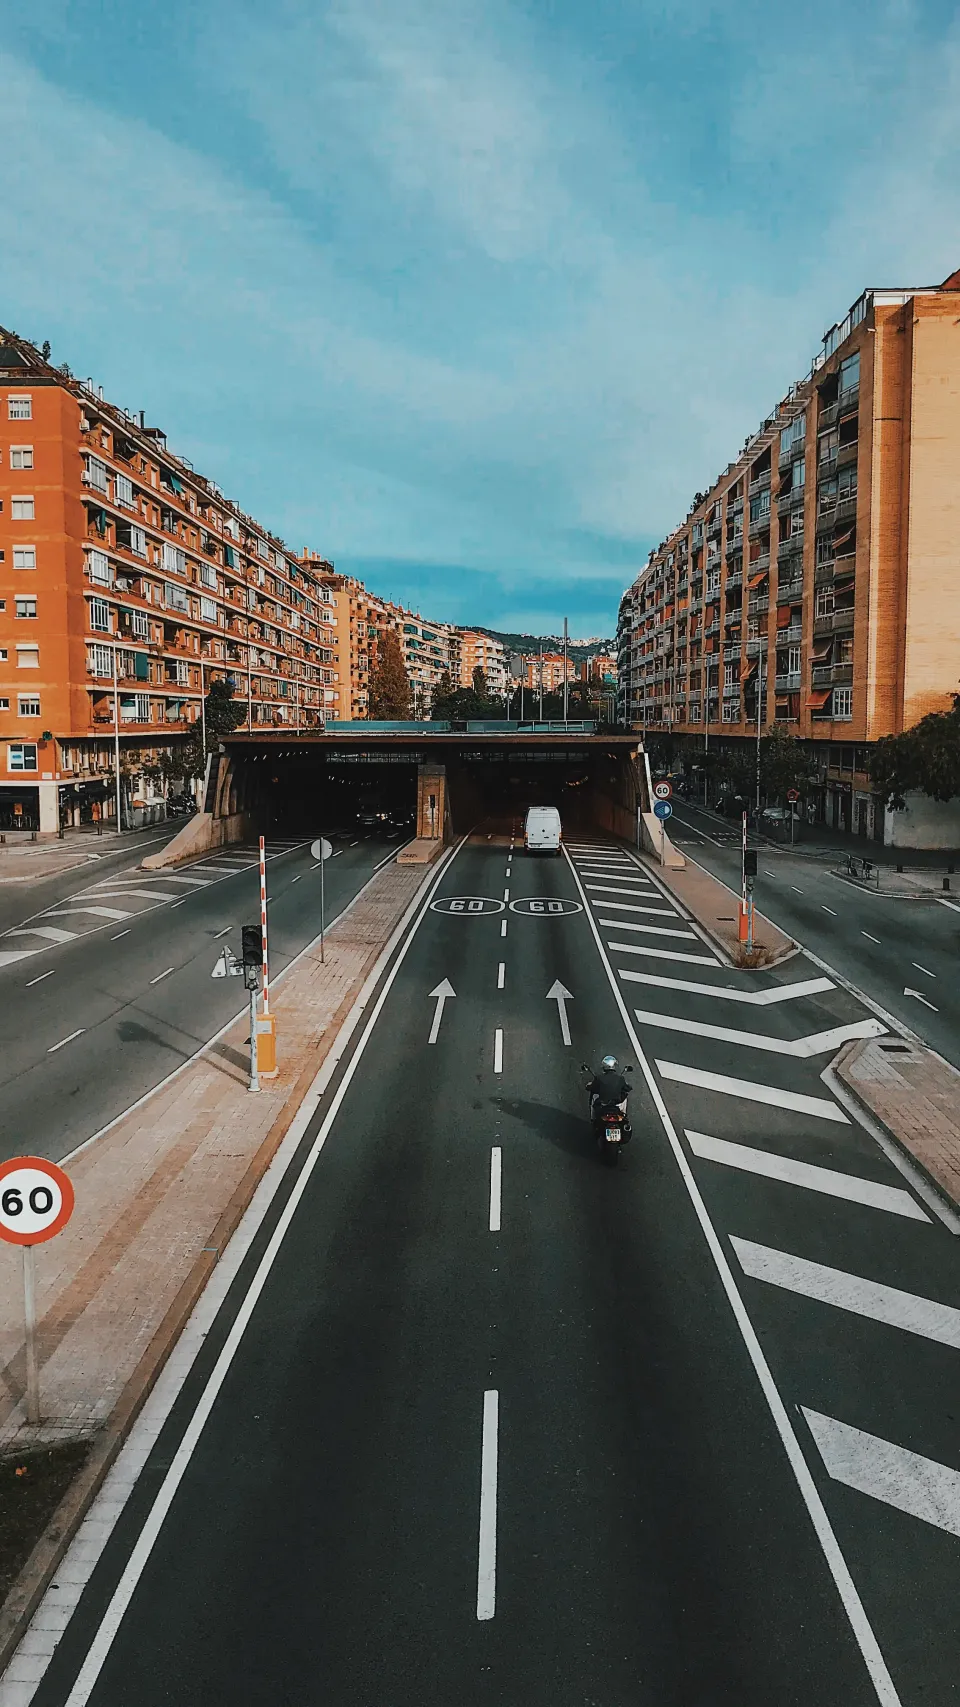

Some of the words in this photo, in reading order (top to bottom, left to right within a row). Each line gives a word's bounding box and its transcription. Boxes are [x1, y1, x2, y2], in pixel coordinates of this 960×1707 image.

[449, 900, 483, 911] 60
[529, 901, 564, 912] 60
[1, 1186, 53, 1216] 60
